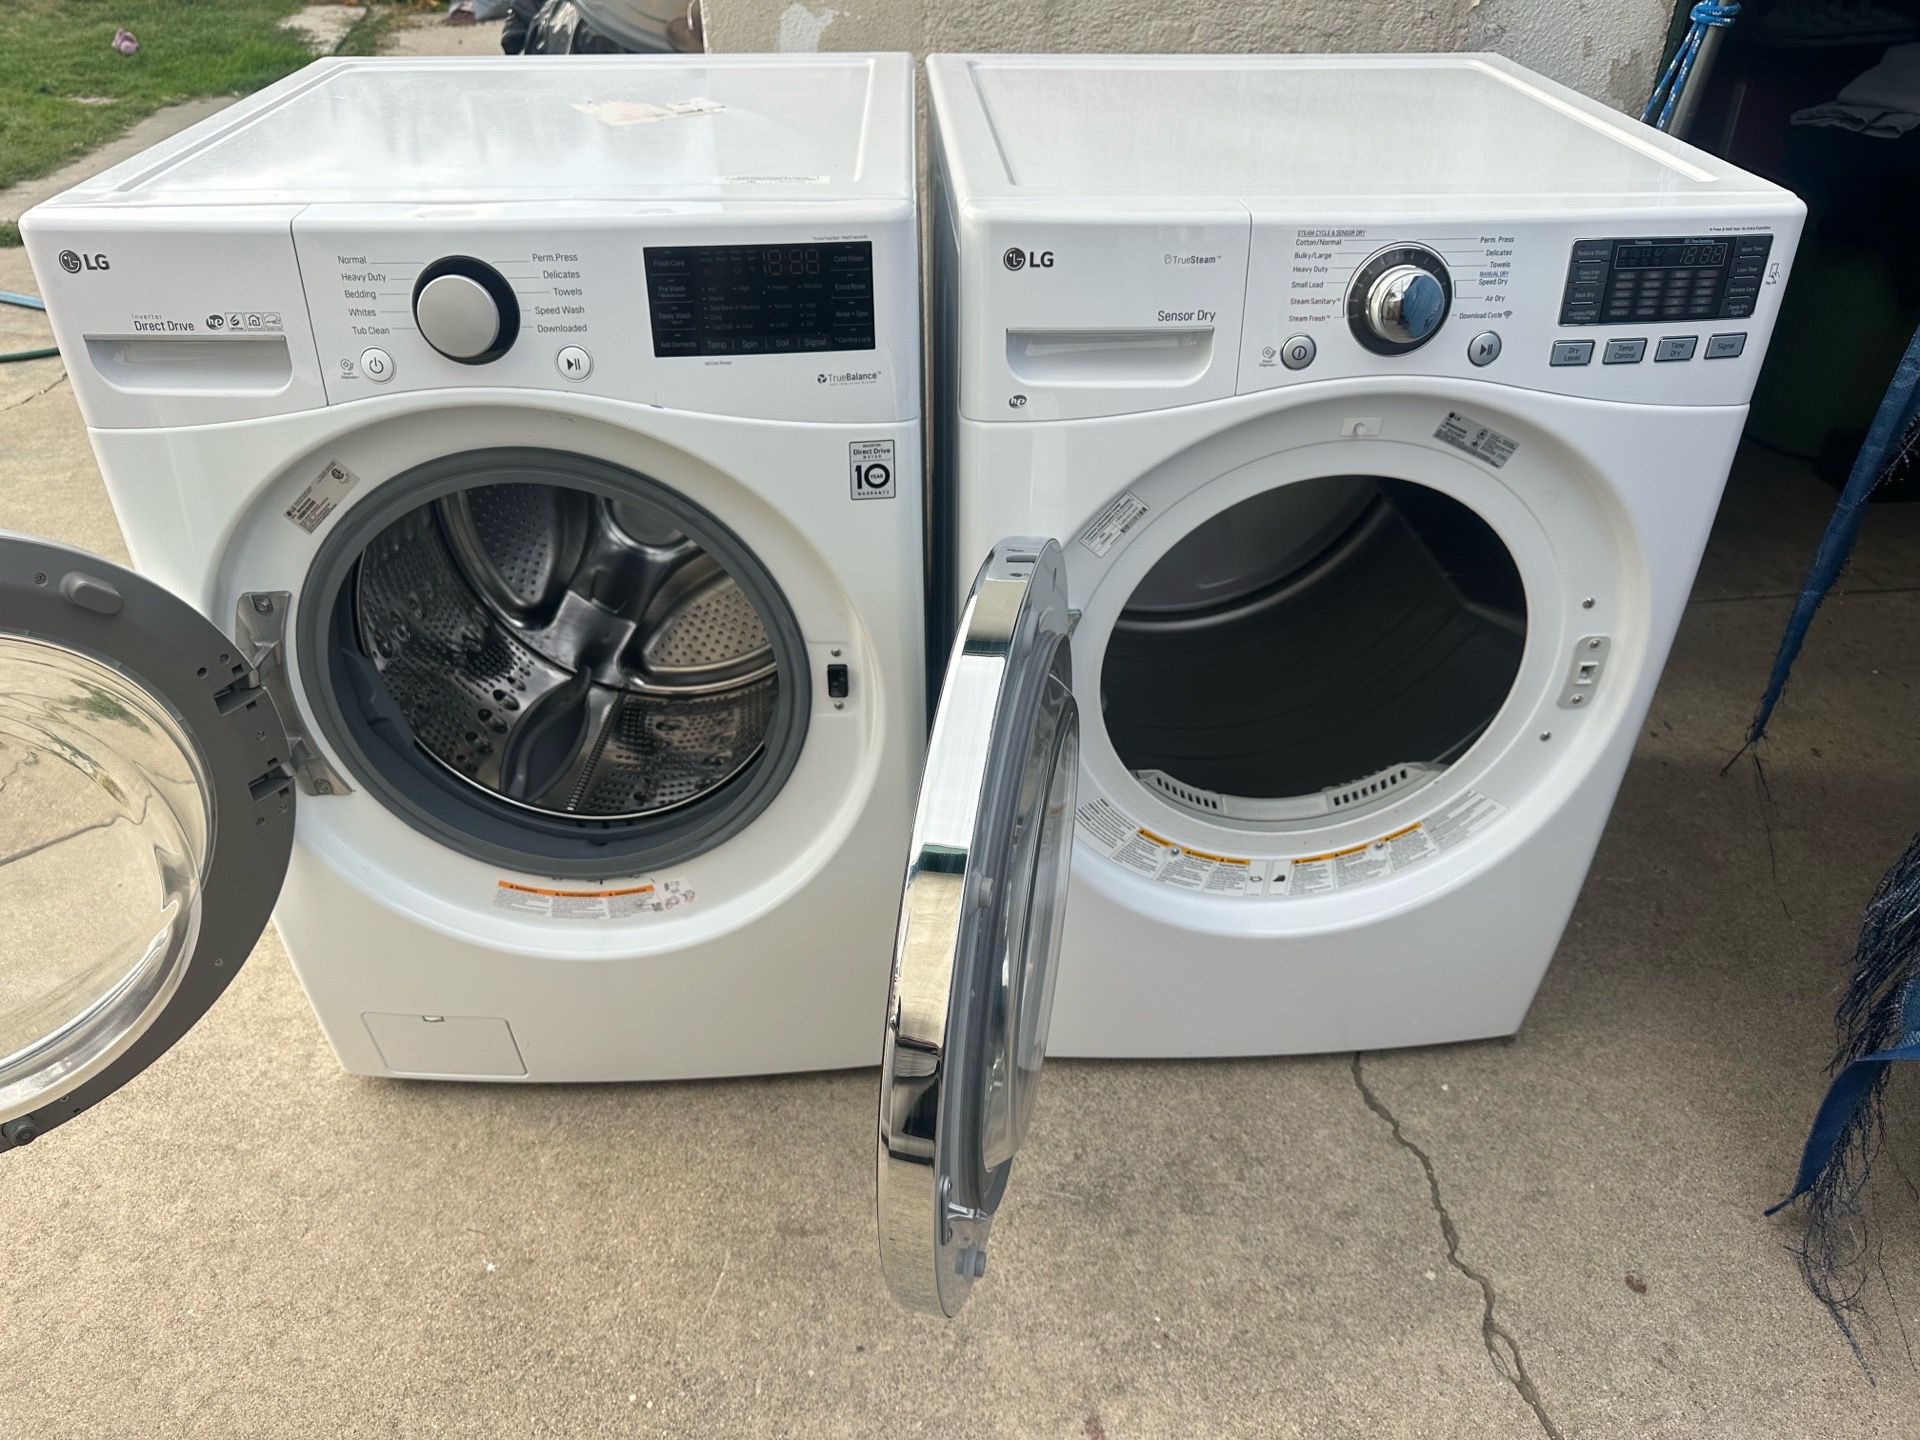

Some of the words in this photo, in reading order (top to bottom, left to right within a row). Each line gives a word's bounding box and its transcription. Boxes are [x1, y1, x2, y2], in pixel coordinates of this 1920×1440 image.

[338, 256, 367, 264] Normal
[555, 253, 578, 262] Press
[1029, 251, 1054, 268] LG
[1294, 252, 1332, 260] Bulky/Large
[82, 254, 110, 270] LG
[1292, 266, 1312, 274] Heavy
[1314, 266, 1328, 274] Duty
[341, 273, 366, 282] Heavy
[368, 272, 386, 282] Duty
[542, 270, 580, 280] Delicates
[1478, 278, 1496, 286] Speed
[1498, 278, 1508, 286] Dry
[344, 290, 376, 300] Bedding
[553, 288, 582, 296] Towels
[348, 308, 376, 317] Whites
[534, 306, 560, 316] Speed
[561, 306, 586, 315] Wash
[1459, 312, 1487, 320] Download
[1487, 311, 1502, 320] Cycle
[1157, 310, 1194, 322] Sensor
[1196, 309, 1216, 324] Dry
[134, 320, 166, 332] Direct
[168, 320, 195, 332] Drive
[352, 326, 367, 335] Tub
[368, 326, 390, 335] Clean
[537, 324, 588, 334] Downloaded
[1718, 342, 1735, 350] Signal
[1614, 352, 1636, 360] Control
[853, 448, 872, 456] Direct
[854, 463, 890, 490] 10
